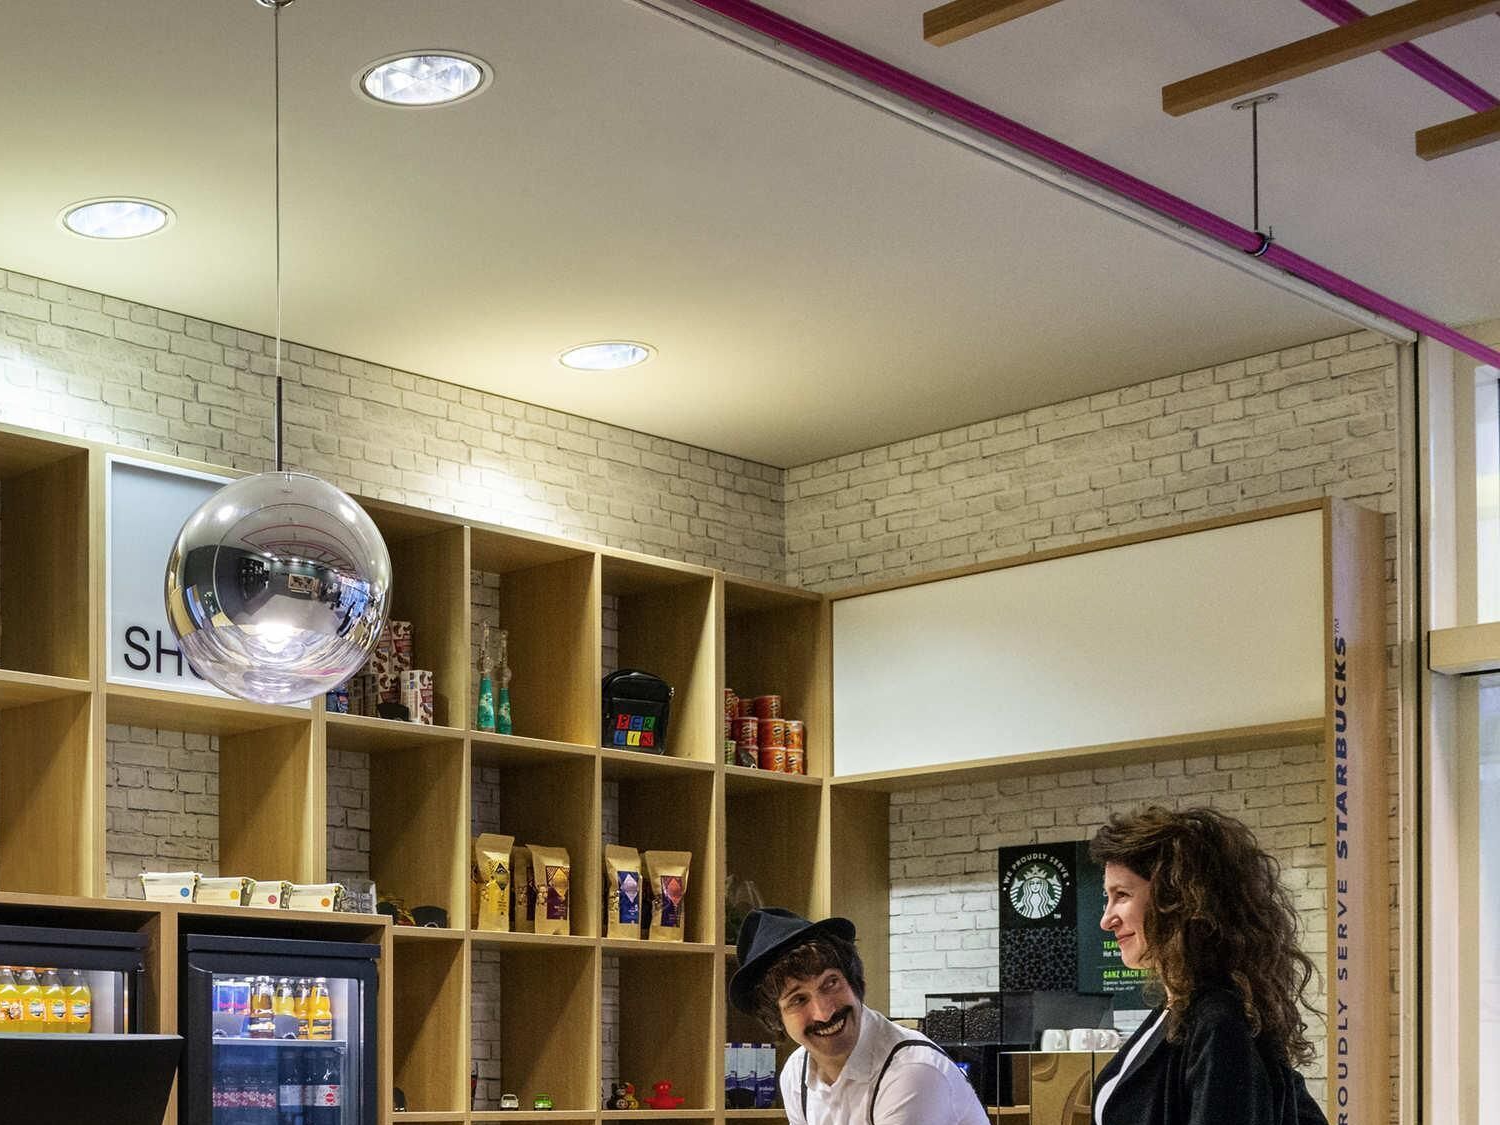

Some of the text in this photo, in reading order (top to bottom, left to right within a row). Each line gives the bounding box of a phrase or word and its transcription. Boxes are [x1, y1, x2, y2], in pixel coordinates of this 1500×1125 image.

[123, 625, 205, 681] SH
[1003, 853, 1069, 884] WE PROUDLY SERVE
[1336, 878, 1349, 981] SERVE
[1103, 970, 1120, 979] GANZ
[1122, 970, 1139, 978] NACH
